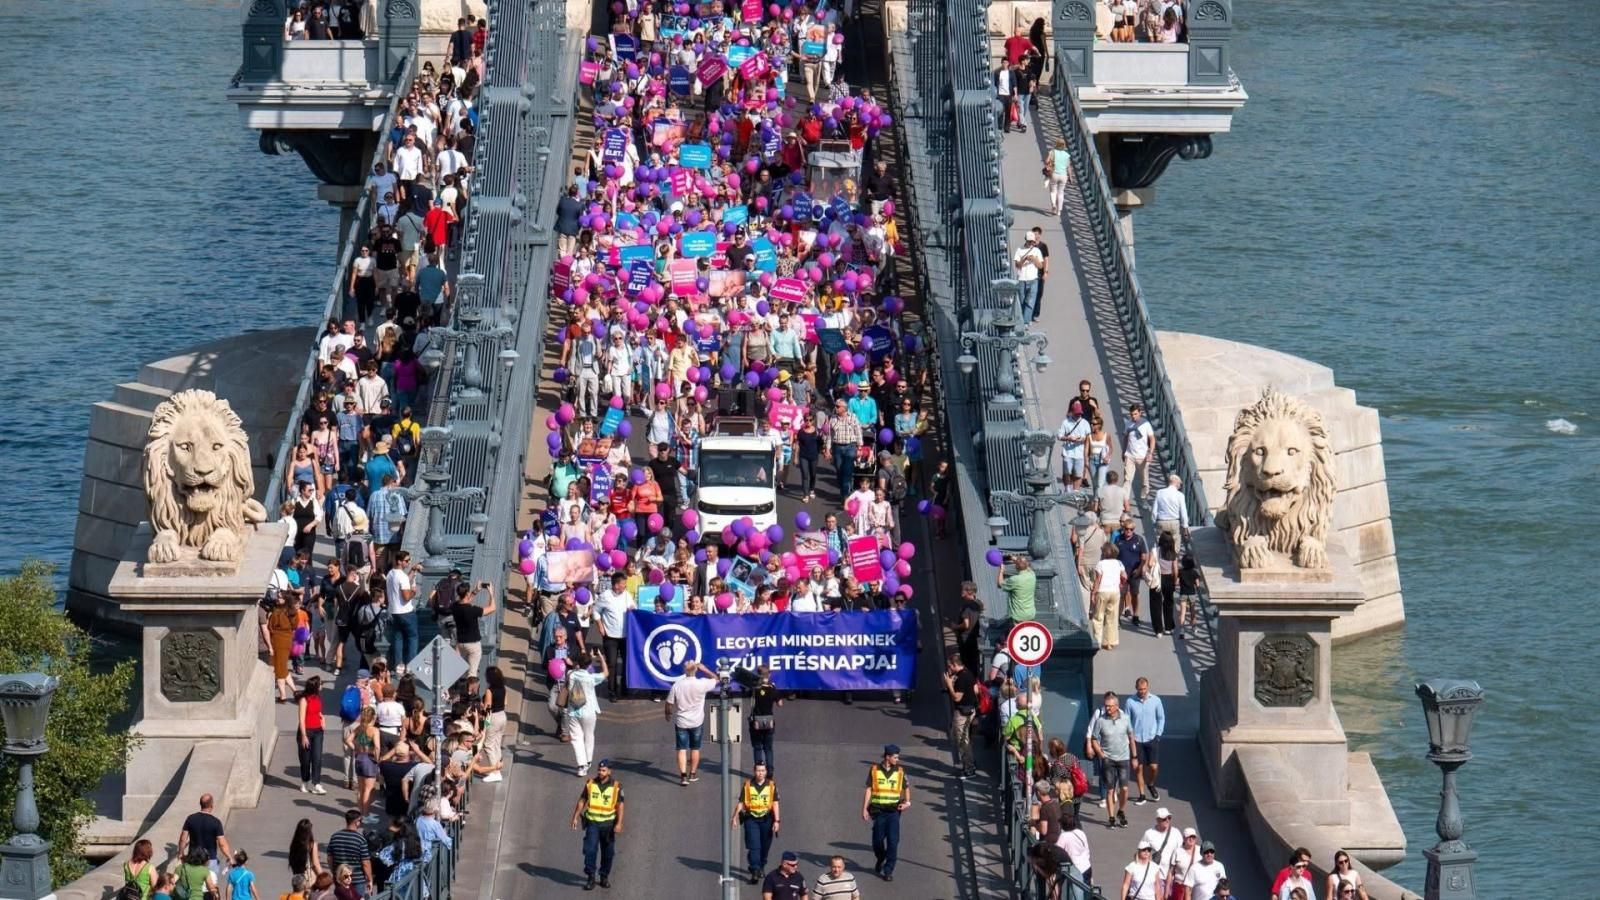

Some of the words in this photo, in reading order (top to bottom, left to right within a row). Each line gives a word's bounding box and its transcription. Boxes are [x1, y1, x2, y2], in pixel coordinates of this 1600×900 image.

[716, 635, 777, 650] LEGYEN
[782, 634, 897, 647] MINDENKINEK
[1019, 635, 1041, 652] 30
